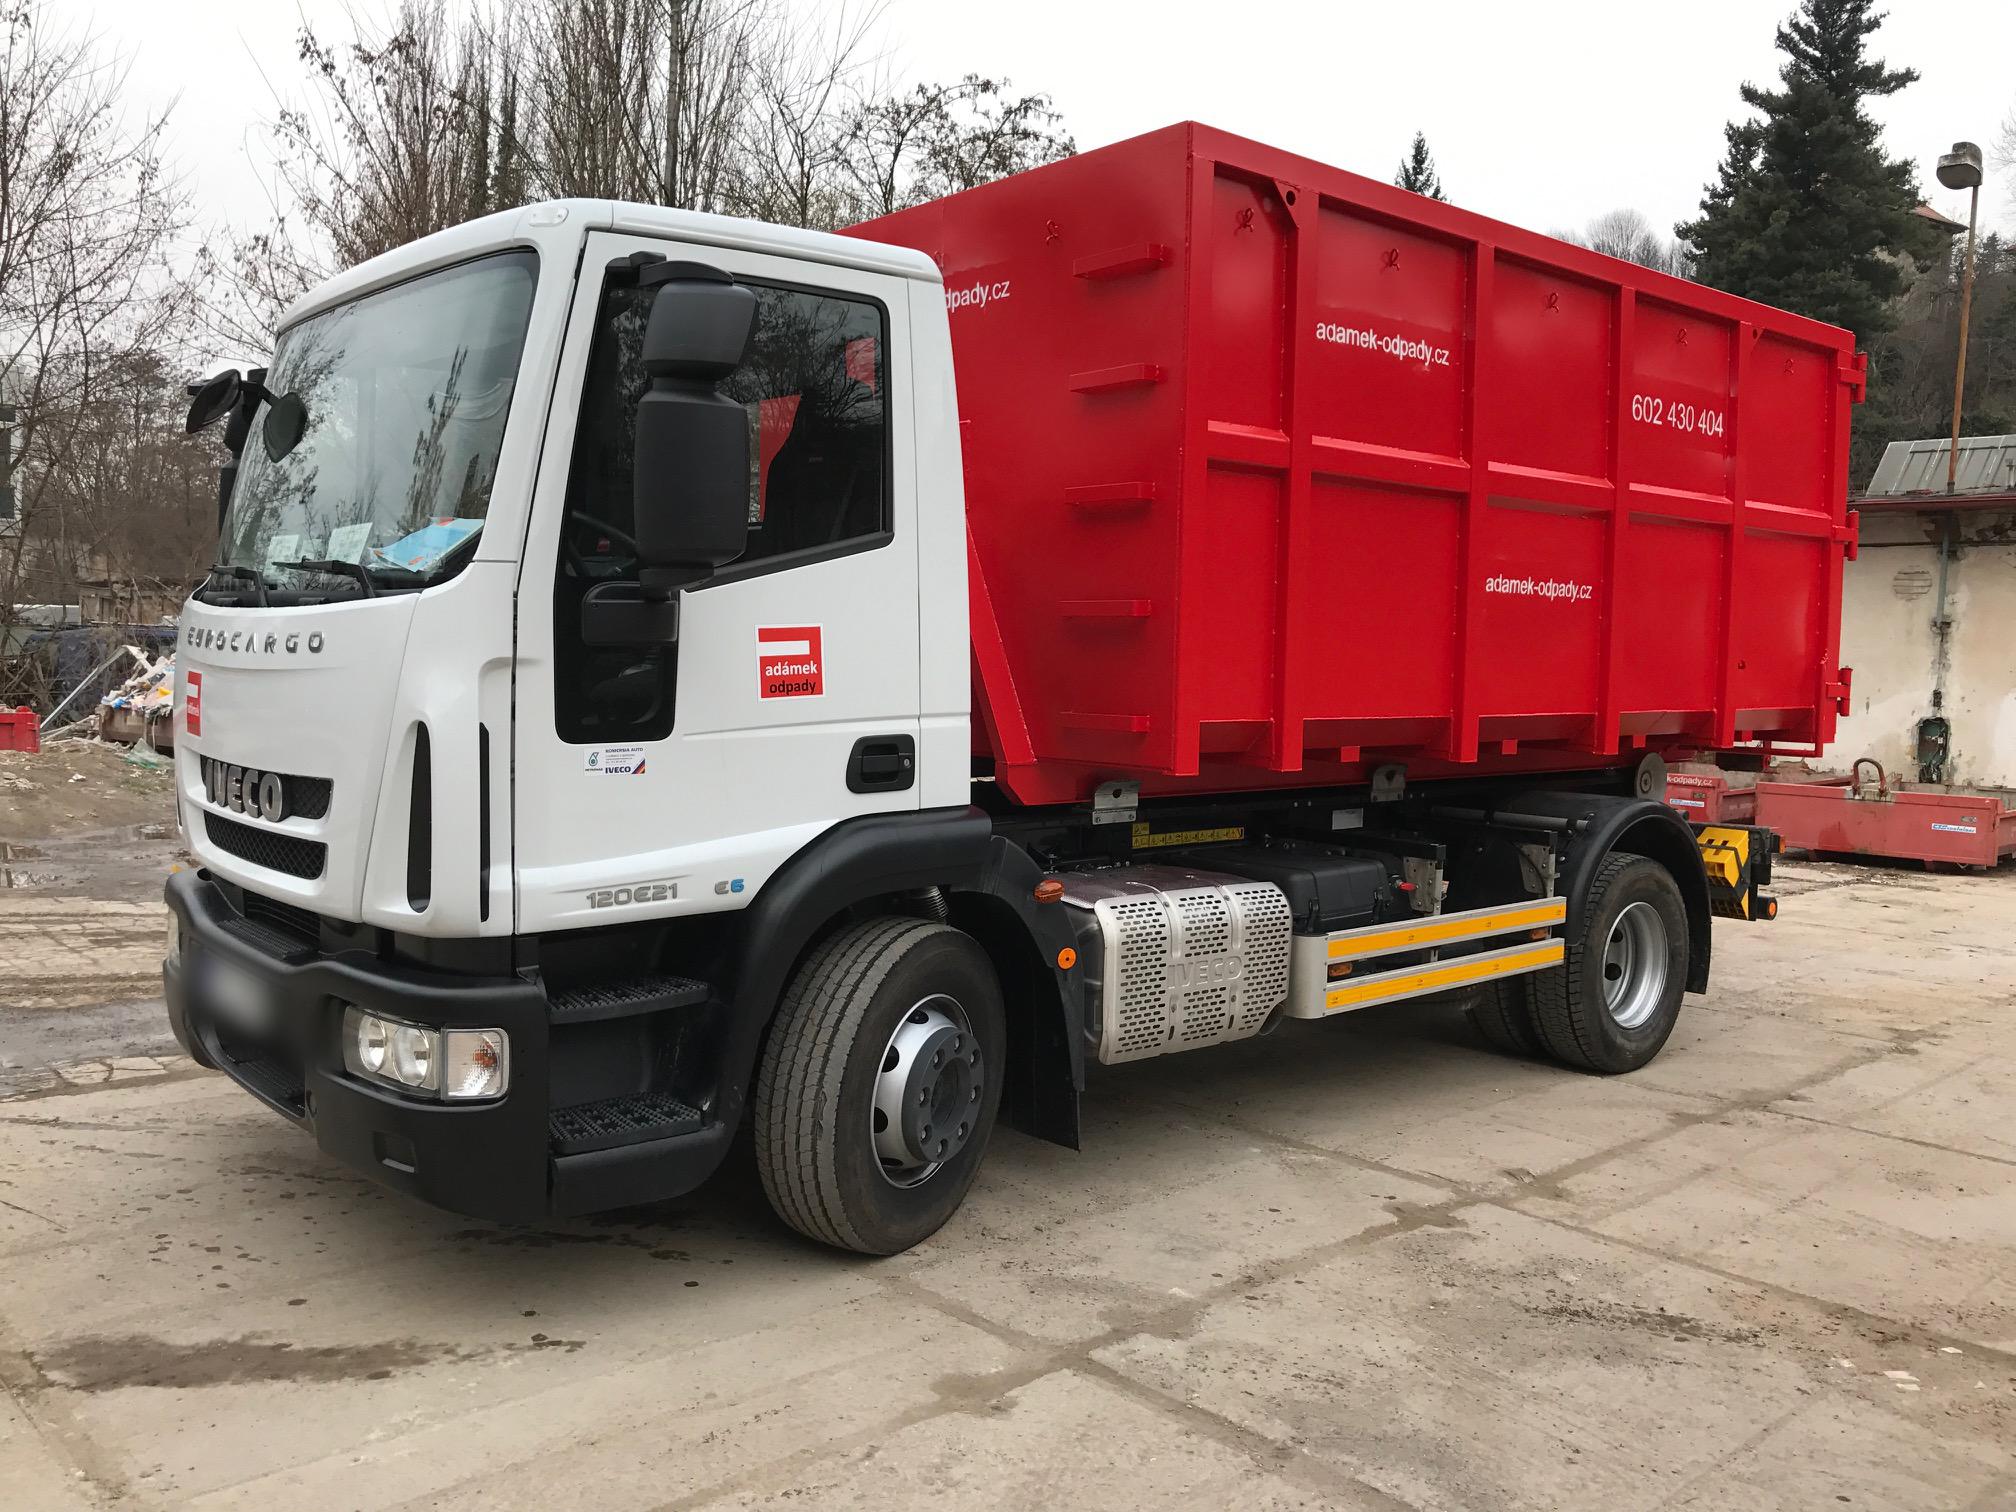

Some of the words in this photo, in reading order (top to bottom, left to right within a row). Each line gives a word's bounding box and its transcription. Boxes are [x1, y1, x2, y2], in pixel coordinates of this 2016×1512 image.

[1316, 322, 1450, 366] adamek-odpady.cz
[1632, 394, 1663, 425] 602
[1667, 402, 1695, 432] 430
[1698, 409, 1723, 438] 404
[1485, 573, 1593, 602] adamek-odpady.cz
[187, 626, 326, 654] EUROCARGO
[765, 660, 818, 676] adámek
[769, 679, 816, 695] odpady
[605, 766, 631, 774] IVECO
[205, 758, 284, 823] IVECO
[586, 882, 678, 909] 120E21
[714, 878, 745, 895] E6
[1167, 956, 1242, 989] IVECO
